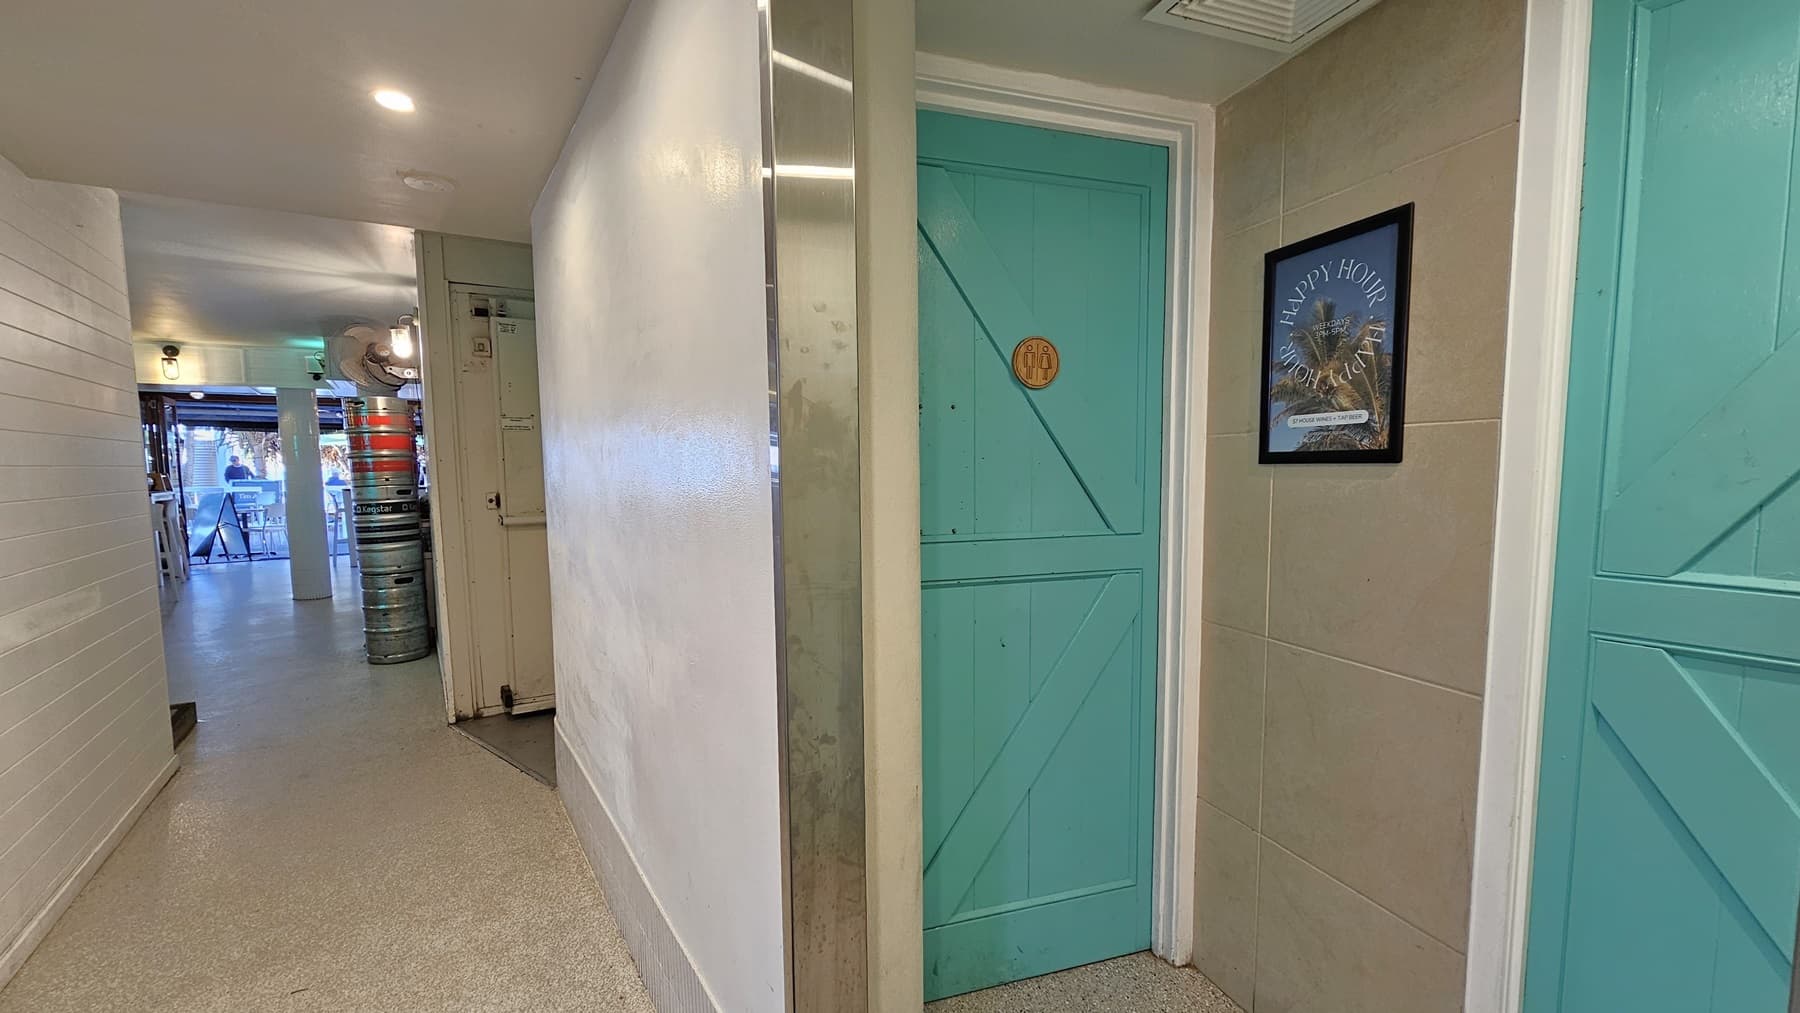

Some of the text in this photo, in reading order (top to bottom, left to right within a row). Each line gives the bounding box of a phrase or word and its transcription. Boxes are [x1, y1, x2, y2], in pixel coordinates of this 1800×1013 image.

[1279, 258, 1387, 326] HAPPY HOUR
[1312, 316, 1351, 331] WEEKDAYS
[1279, 325, 1386, 389] HAPPY HOUR
[1299, 416, 1315, 424] HOUSE
[1316, 414, 1332, 422] WINES
[362, 504, 392, 514] Kegstar
